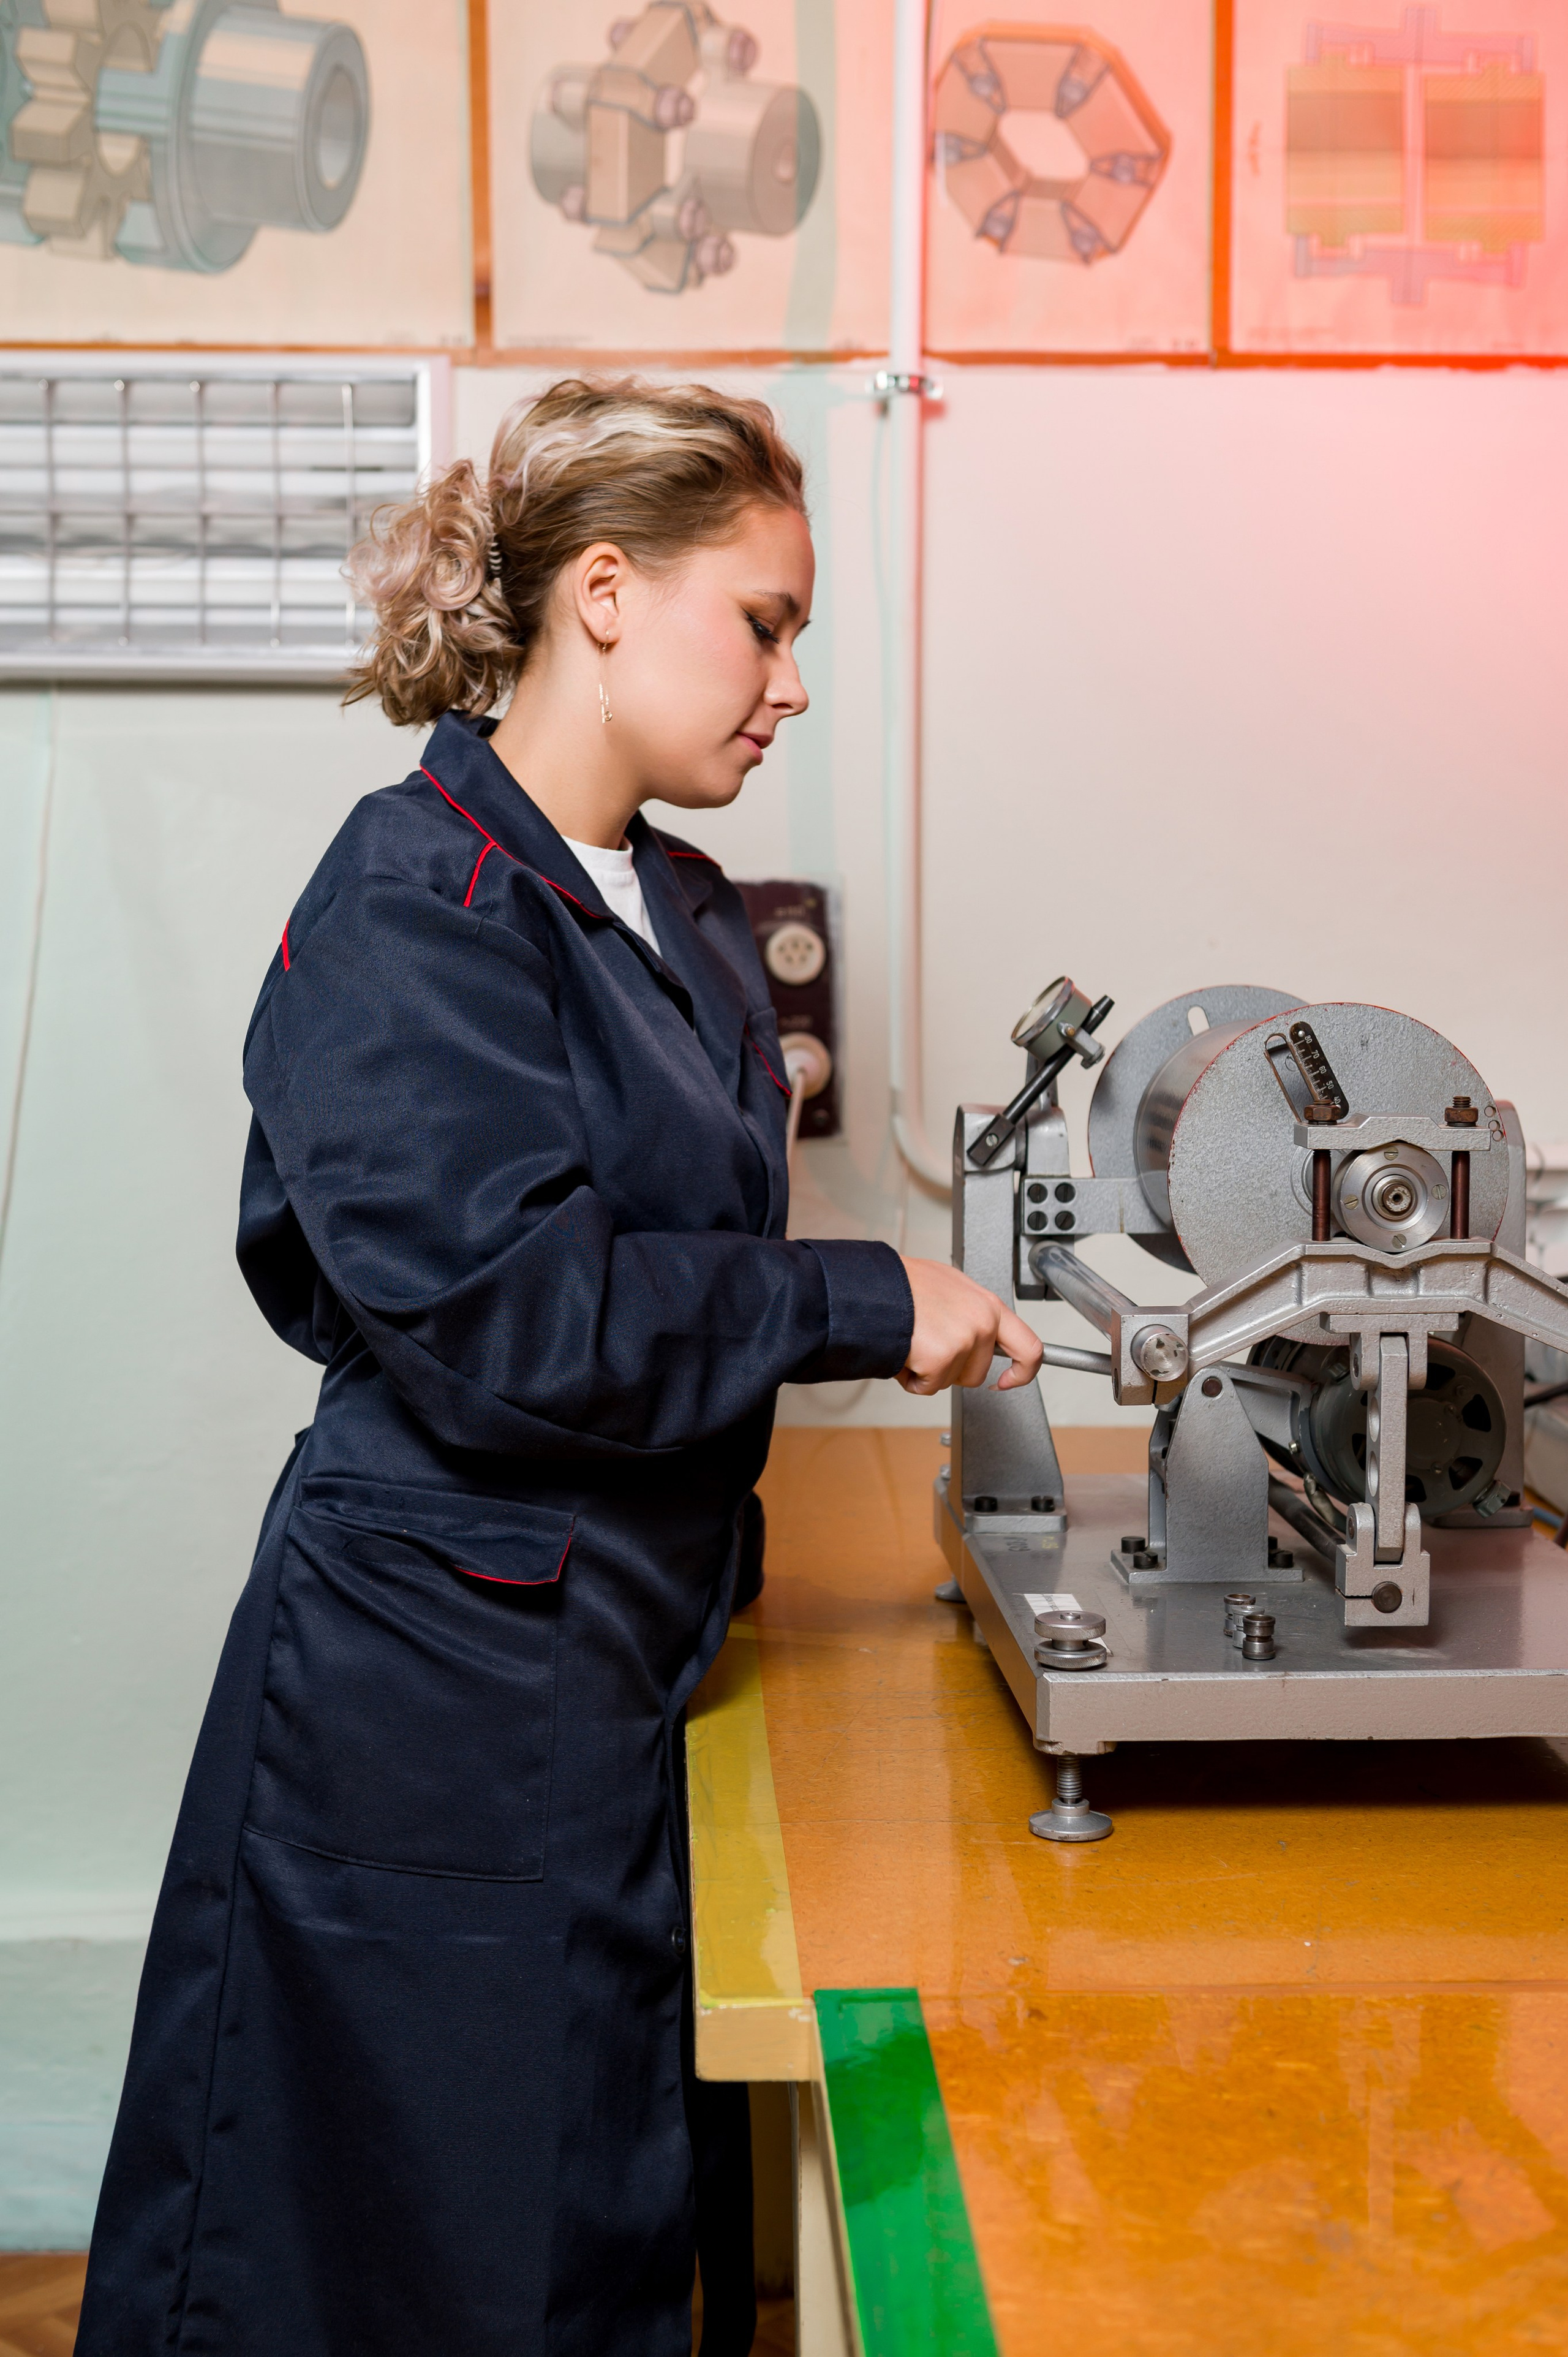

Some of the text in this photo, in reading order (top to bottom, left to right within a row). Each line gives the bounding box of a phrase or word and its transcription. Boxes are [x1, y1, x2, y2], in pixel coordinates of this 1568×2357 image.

[1304, 1035, 1313, 1044] 80
[1311, 1050, 1319, 1059] 70
[1319, 1065, 1327, 1074] 60
[1326, 1080, 1334, 1089] 50
